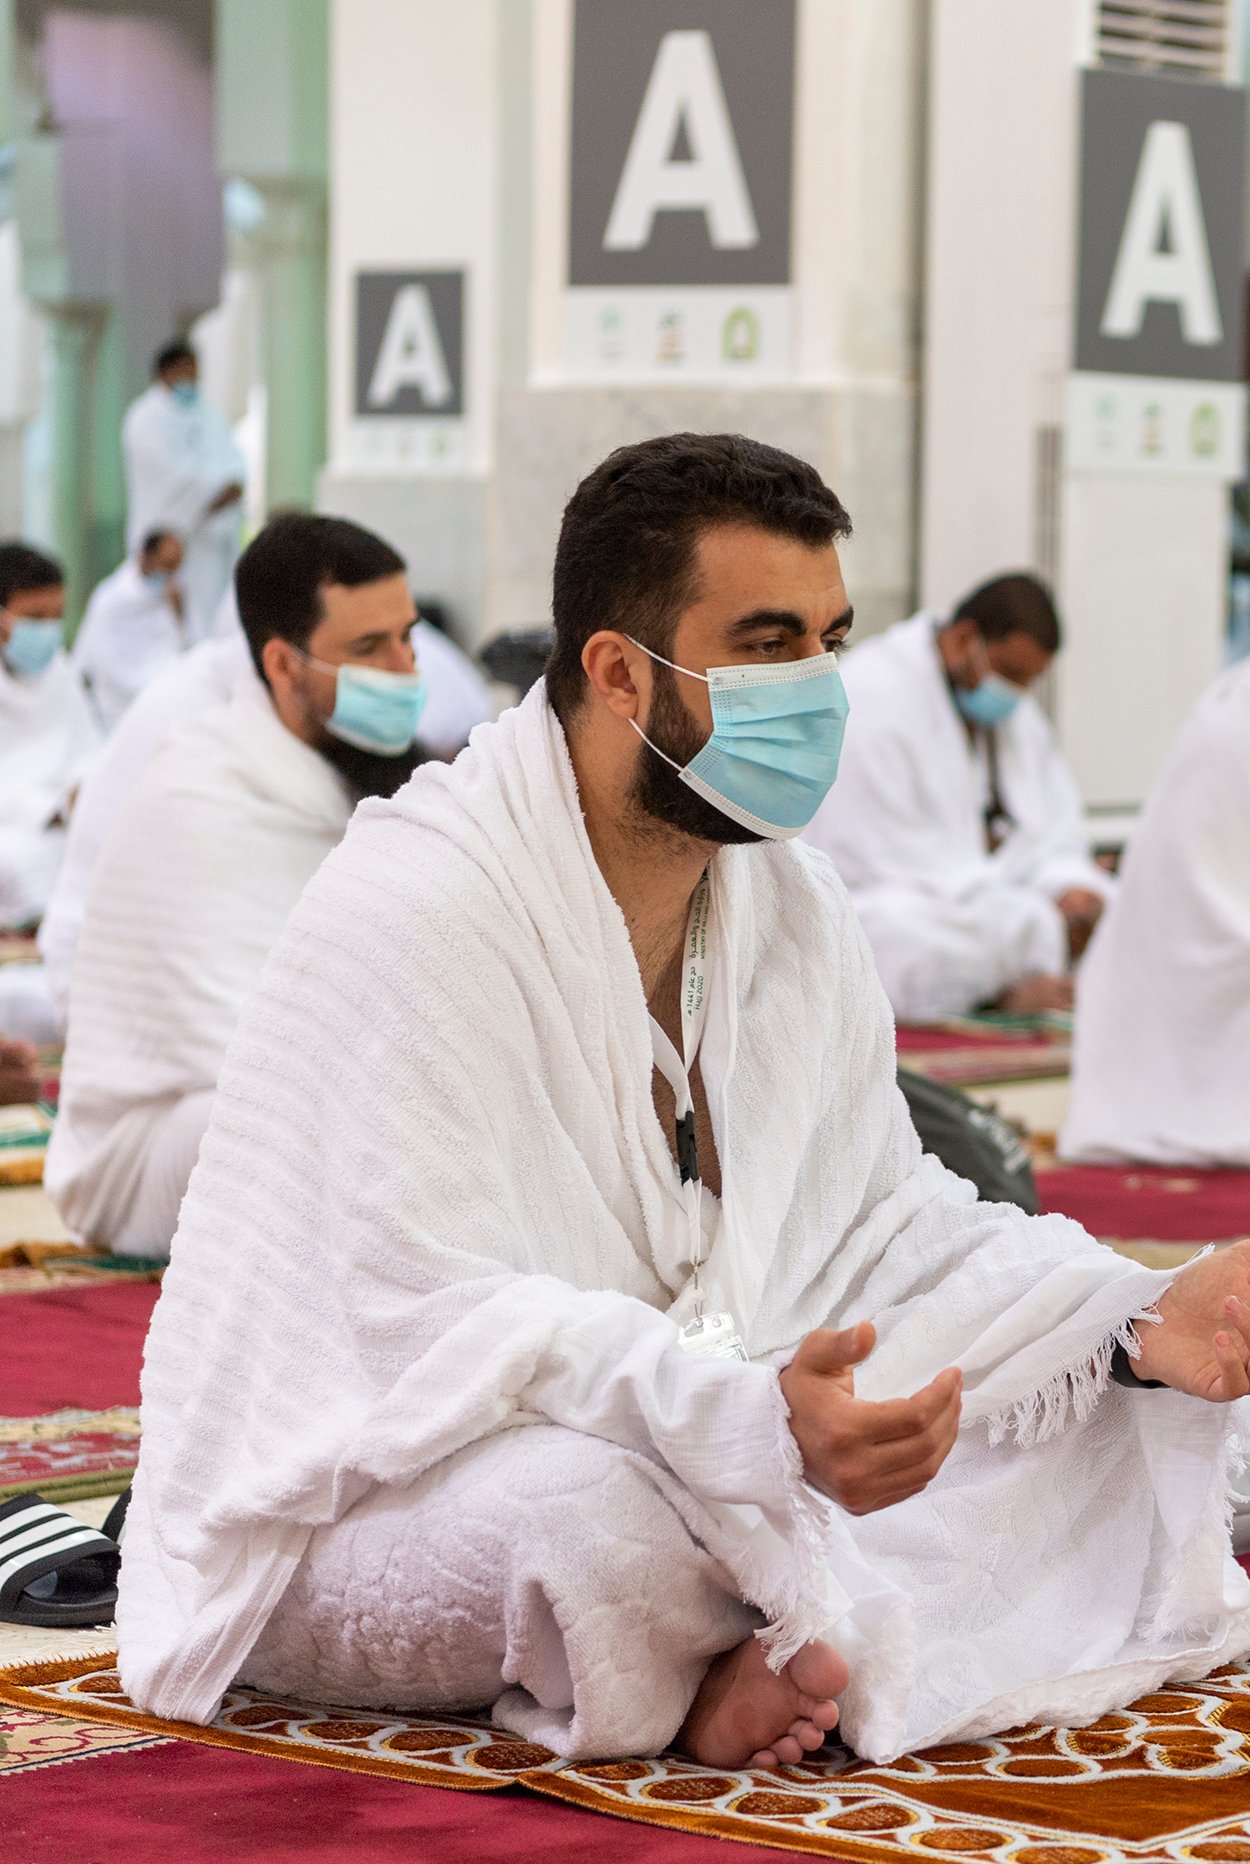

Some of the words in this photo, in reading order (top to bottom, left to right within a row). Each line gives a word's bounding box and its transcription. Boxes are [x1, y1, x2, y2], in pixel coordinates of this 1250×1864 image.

[605, 31, 757, 250] A
[1102, 121, 1221, 346] A
[369, 285, 451, 407] A
[688, 925, 700, 959] والعمرة
[689, 966, 697, 976] حج
[696, 975, 704, 995] 2020
[694, 995, 704, 1010] Hajj
